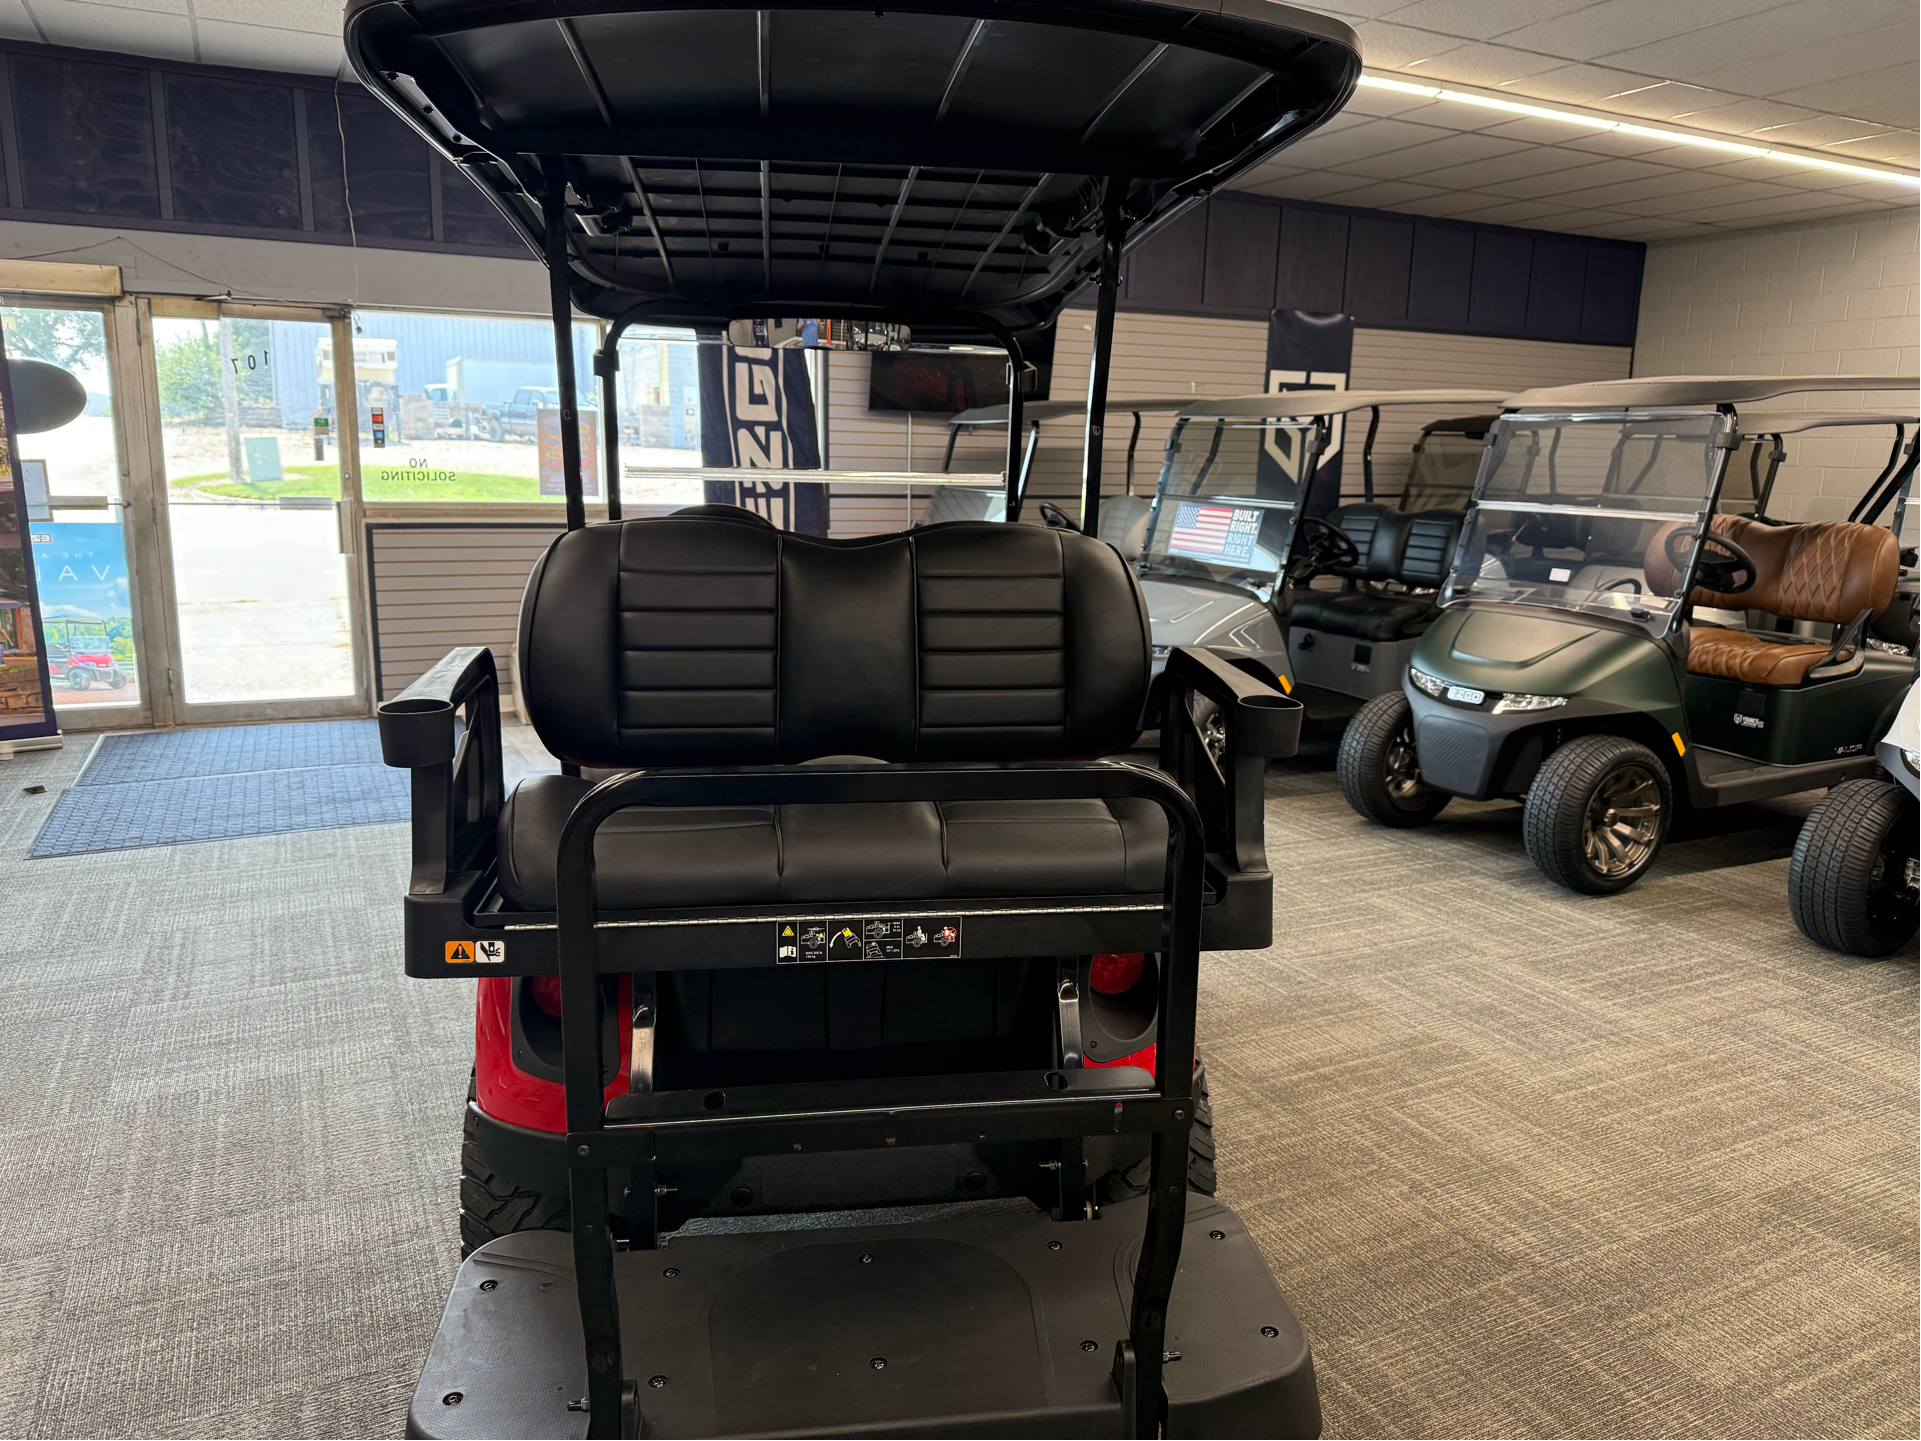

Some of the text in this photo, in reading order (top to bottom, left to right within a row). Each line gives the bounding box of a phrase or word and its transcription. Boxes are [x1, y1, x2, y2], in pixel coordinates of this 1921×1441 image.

[735, 347, 784, 531] ZG
[1232, 509, 1260, 522] BUILT
[1229, 522, 1258, 535] RIGHT.
[1226, 533, 1255, 546] RIGHT
[1223, 544, 1250, 558] HERE.
